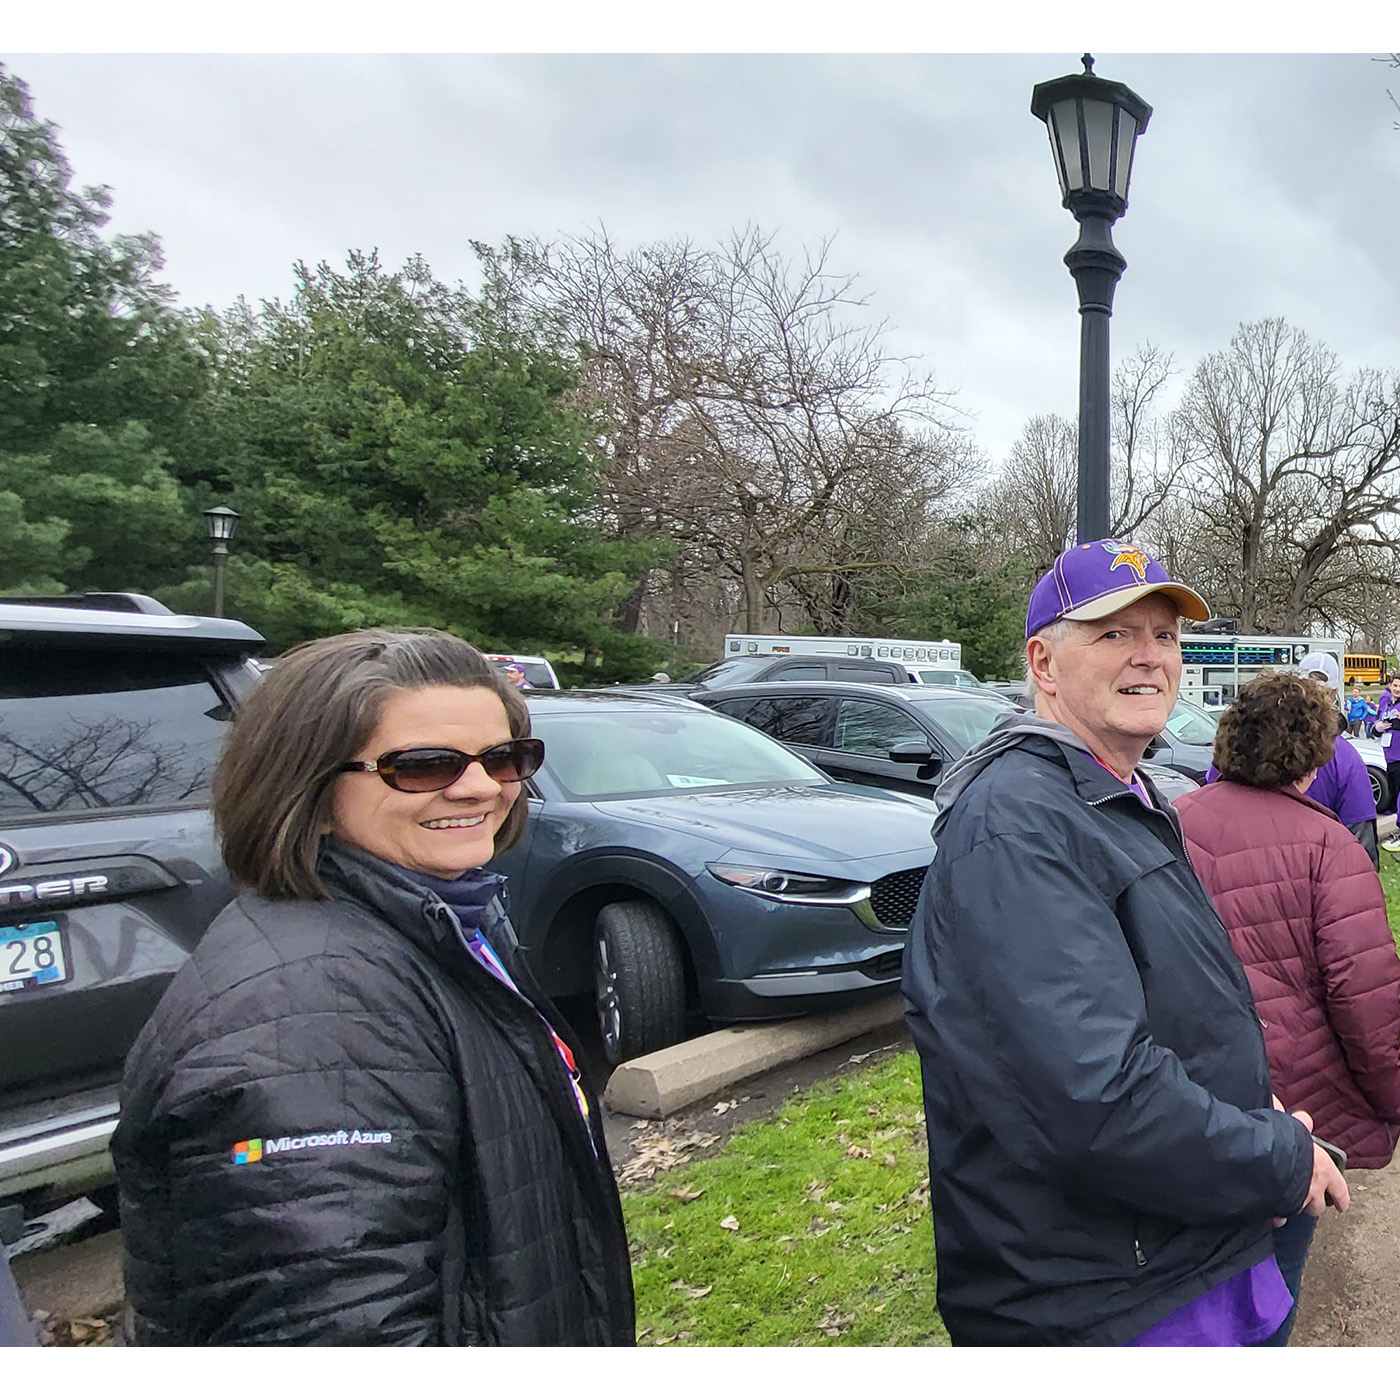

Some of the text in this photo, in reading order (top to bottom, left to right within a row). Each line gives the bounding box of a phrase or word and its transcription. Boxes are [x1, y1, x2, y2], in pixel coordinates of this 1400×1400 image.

[6, 936, 56, 975] 28
[265, 1129, 392, 1154] Microsoft Azure
